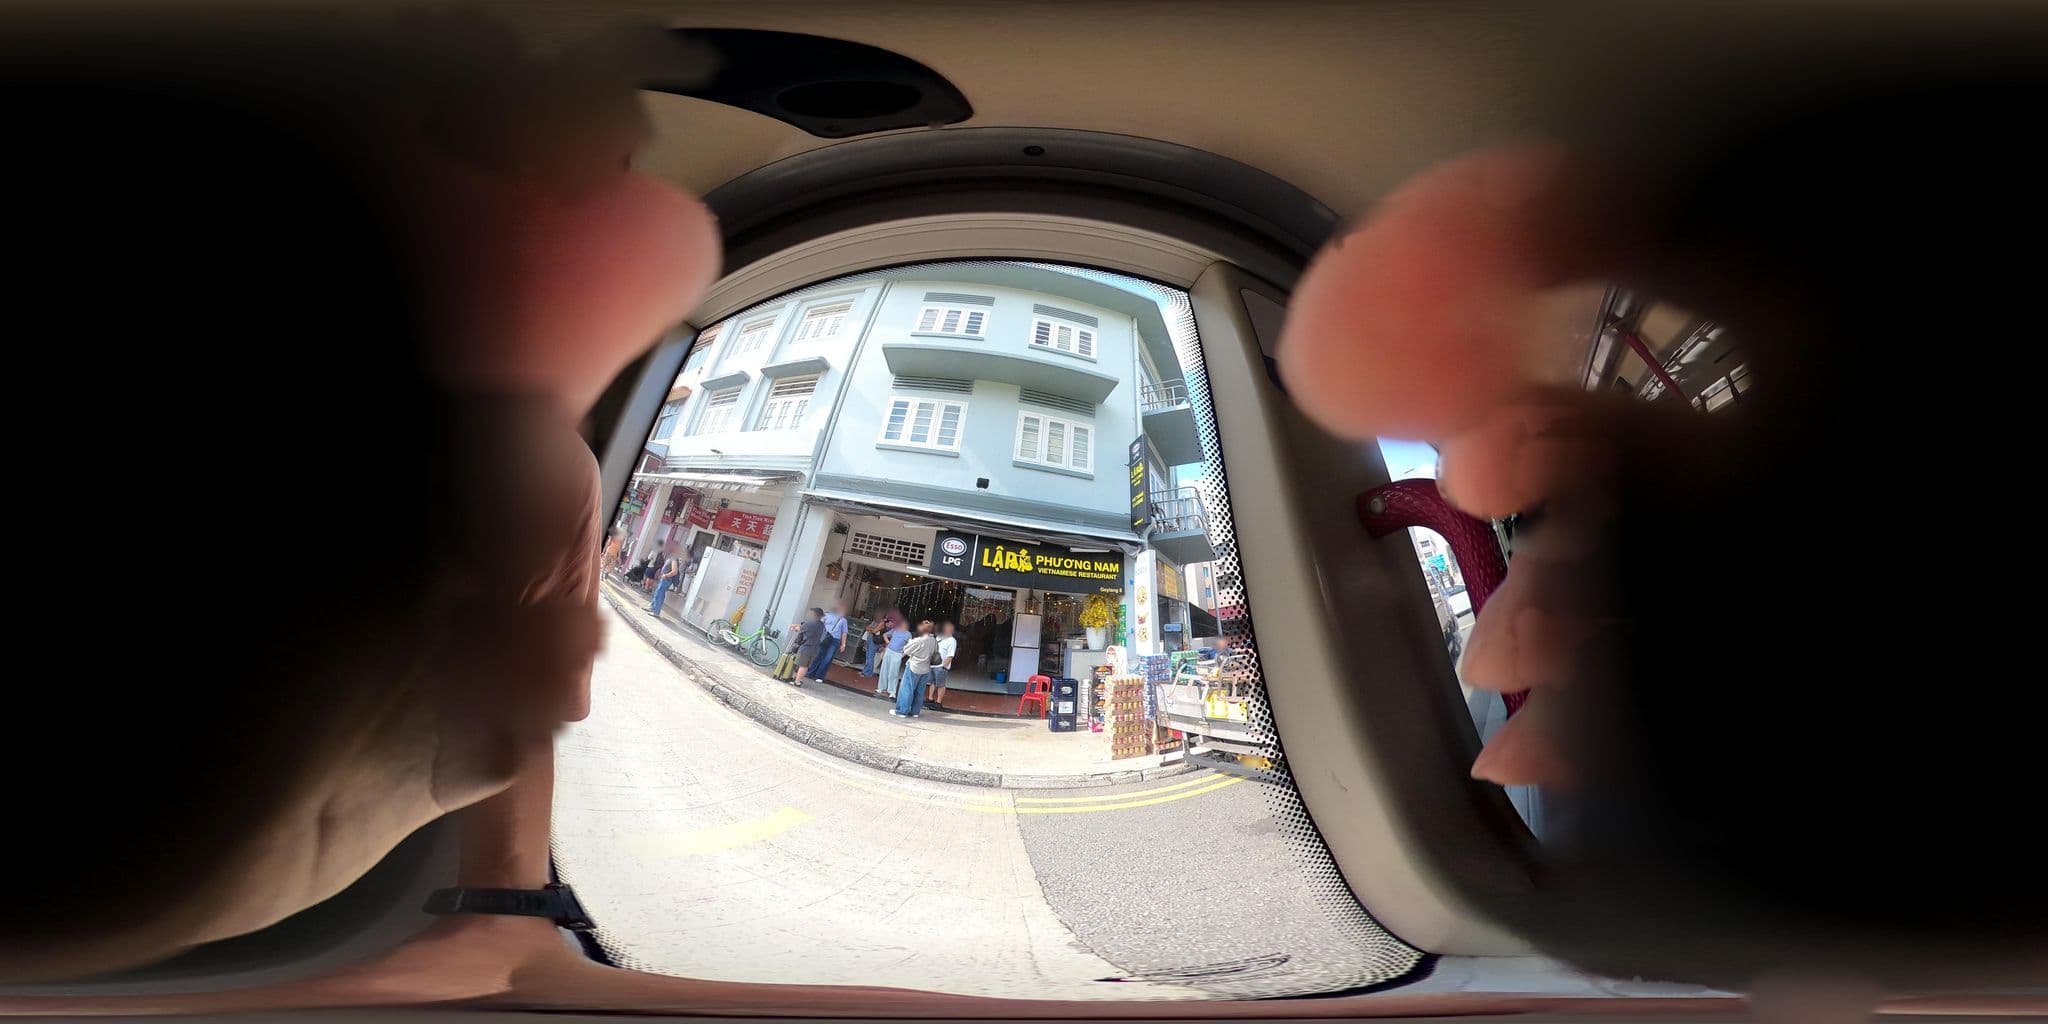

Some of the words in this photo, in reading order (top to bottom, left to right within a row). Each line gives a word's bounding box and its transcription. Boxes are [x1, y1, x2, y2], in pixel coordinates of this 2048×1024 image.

[945, 541, 963, 551] Esso
[1035, 555, 1091, 571] PHƯƠNG
[1094, 561, 1120, 573] NAM
[1037, 567, 1078, 577] VIETNAMESE
[1078, 571, 1117, 580] RESTAURANT
